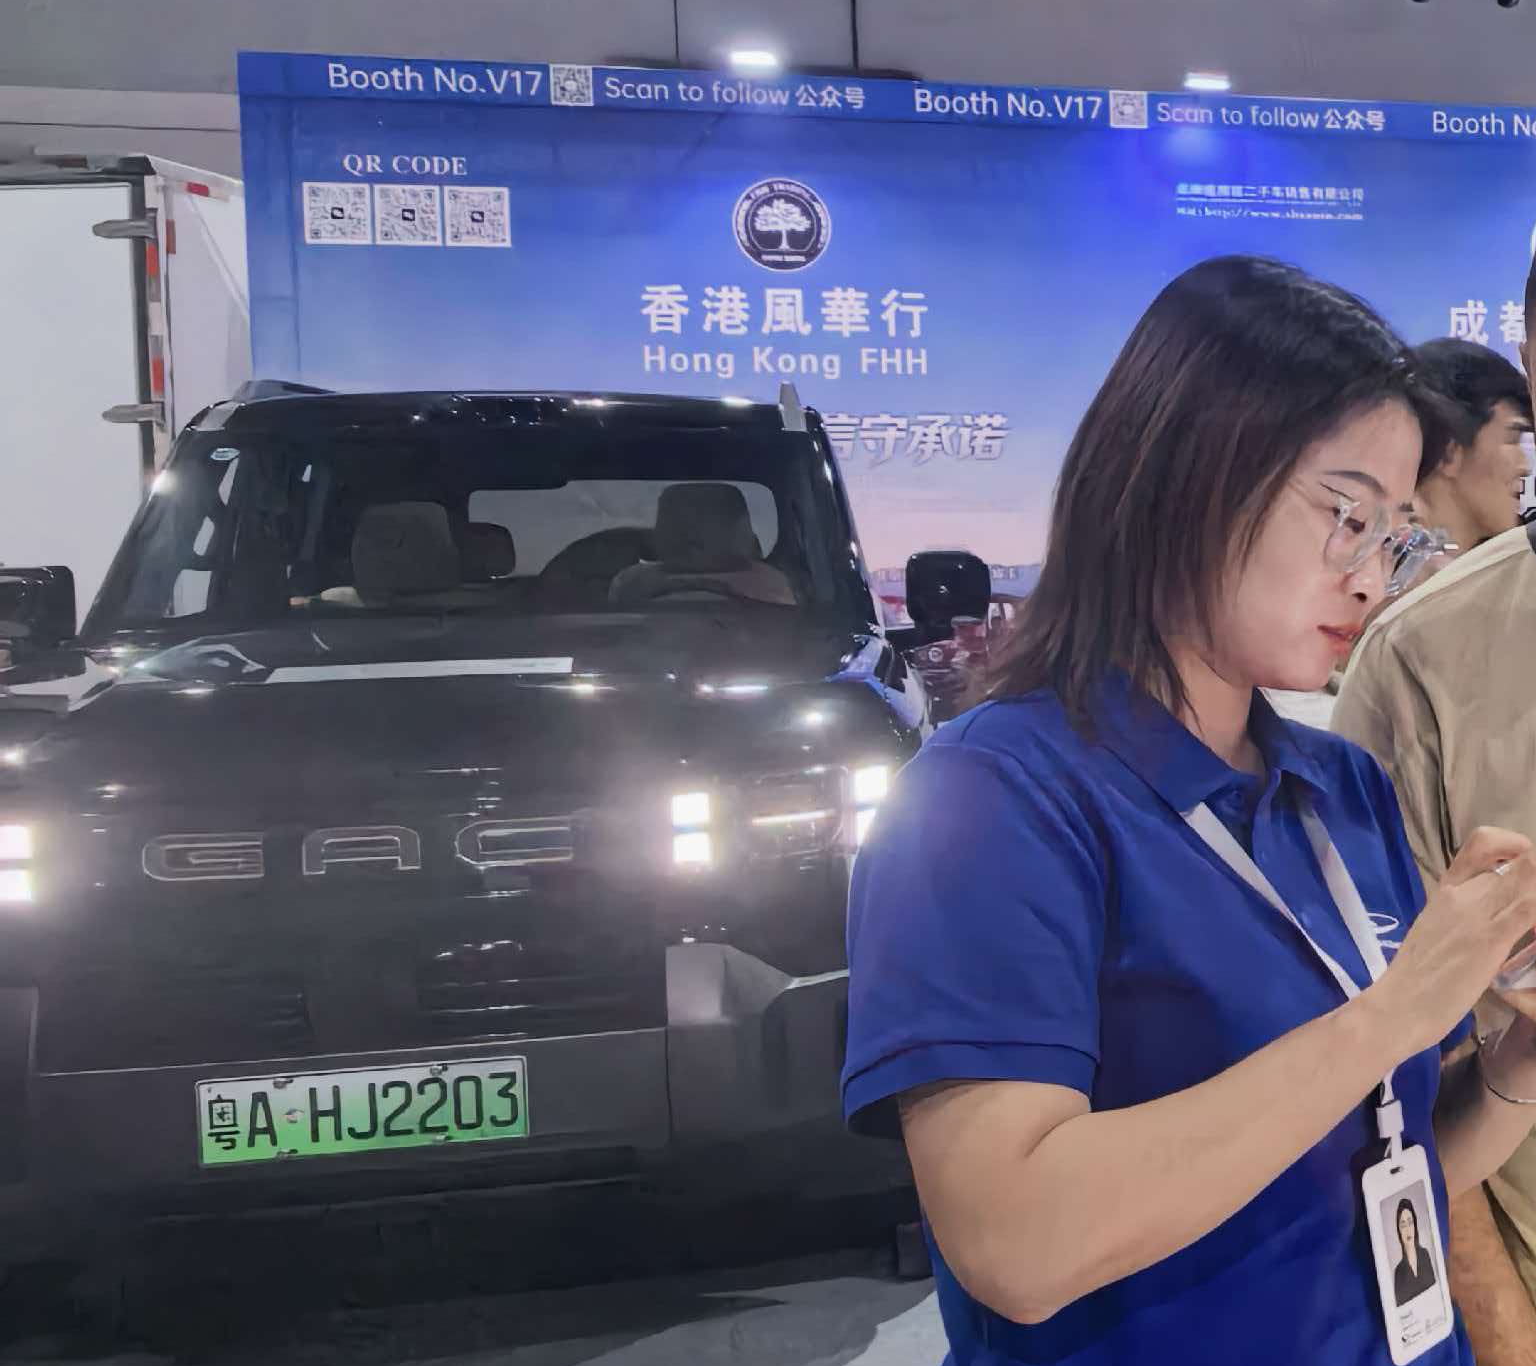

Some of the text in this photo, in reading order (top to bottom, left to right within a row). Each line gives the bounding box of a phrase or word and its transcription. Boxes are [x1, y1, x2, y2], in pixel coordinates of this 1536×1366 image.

[328, 63, 542, 96] Booth No.V17
[605, 77, 866, 109] Scan to follow 公众号
[914, 89, 1102, 119] Booth No.V17
[1157, 103, 1386, 131] Scan to follow 公众号
[1433, 111, 1505, 136] Booth
[343, 154, 468, 176] QR CODE
[641, 285, 928, 337] 香港風華行
[643, 345, 928, 379] Hong Kong FHH
[142, 819, 574, 881] GAC
